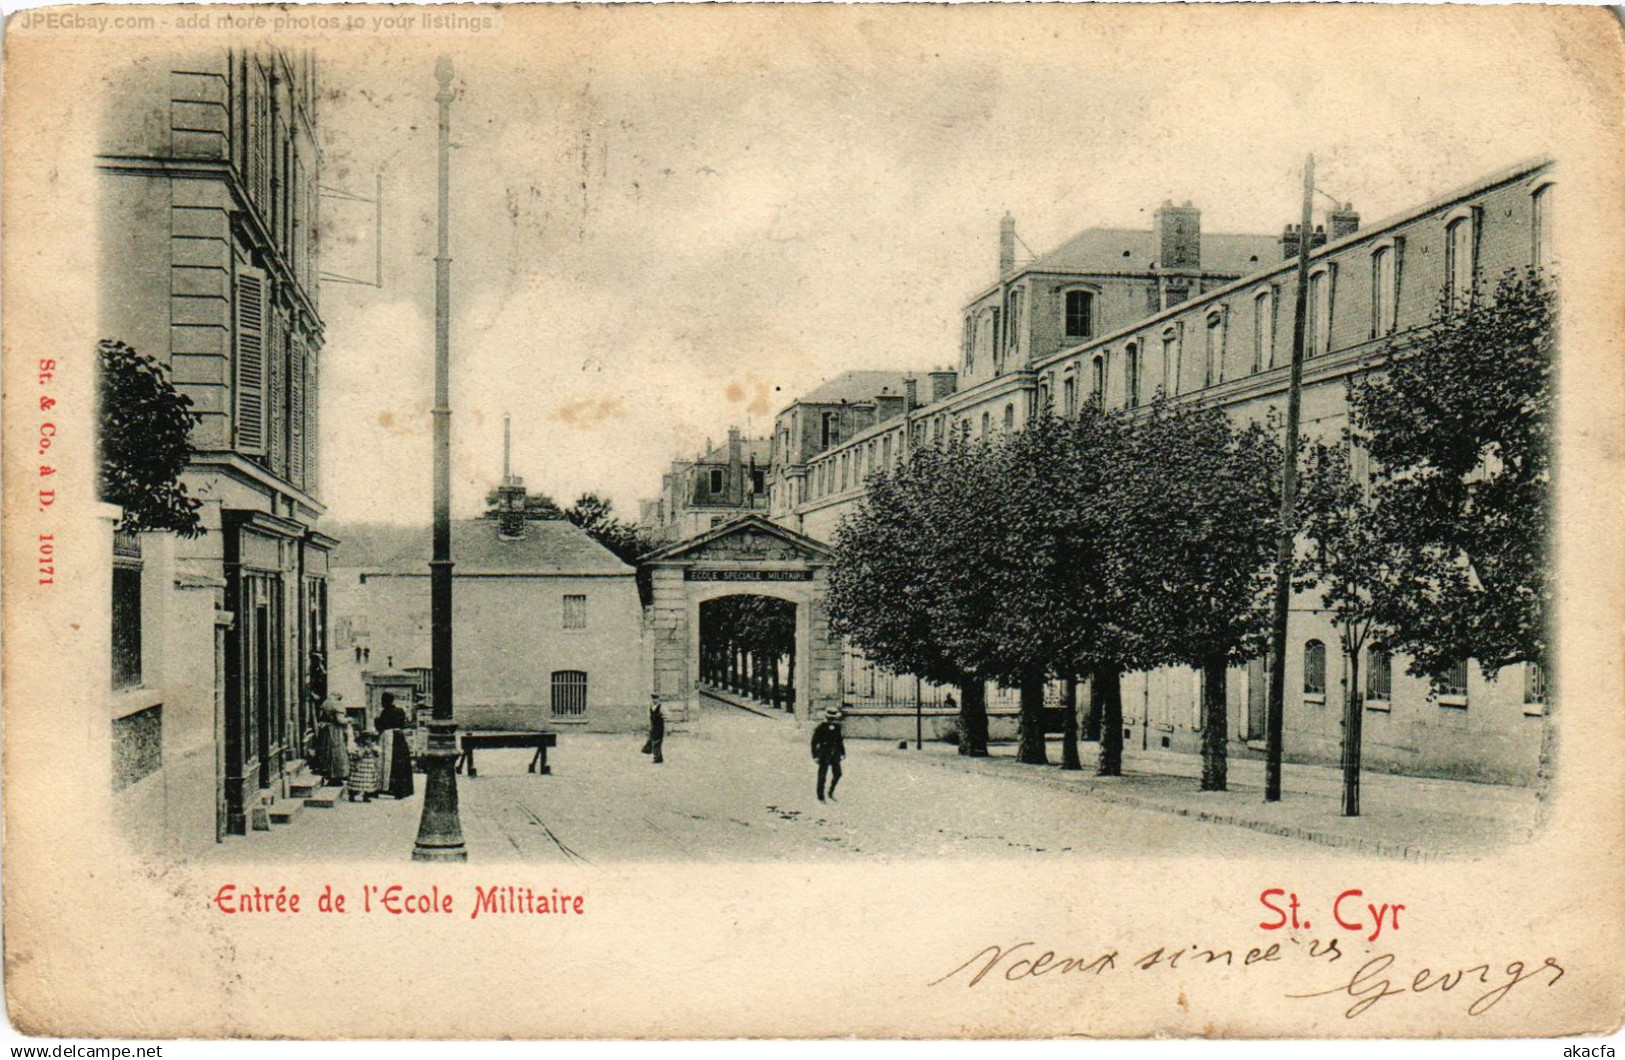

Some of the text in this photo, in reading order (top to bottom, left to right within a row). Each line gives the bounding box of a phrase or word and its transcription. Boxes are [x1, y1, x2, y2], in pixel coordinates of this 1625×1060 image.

[38, 358, 57, 385] St.
[38, 395, 57, 412] &
[38, 421, 57, 455] Co.
[38, 534, 55, 586] 10171
[767, 571, 807, 581] MILITAIRE
[214, 884, 585, 920] Entrée de l'Ecole Militaire
[1259, 888, 1406, 942] St. Cyr
